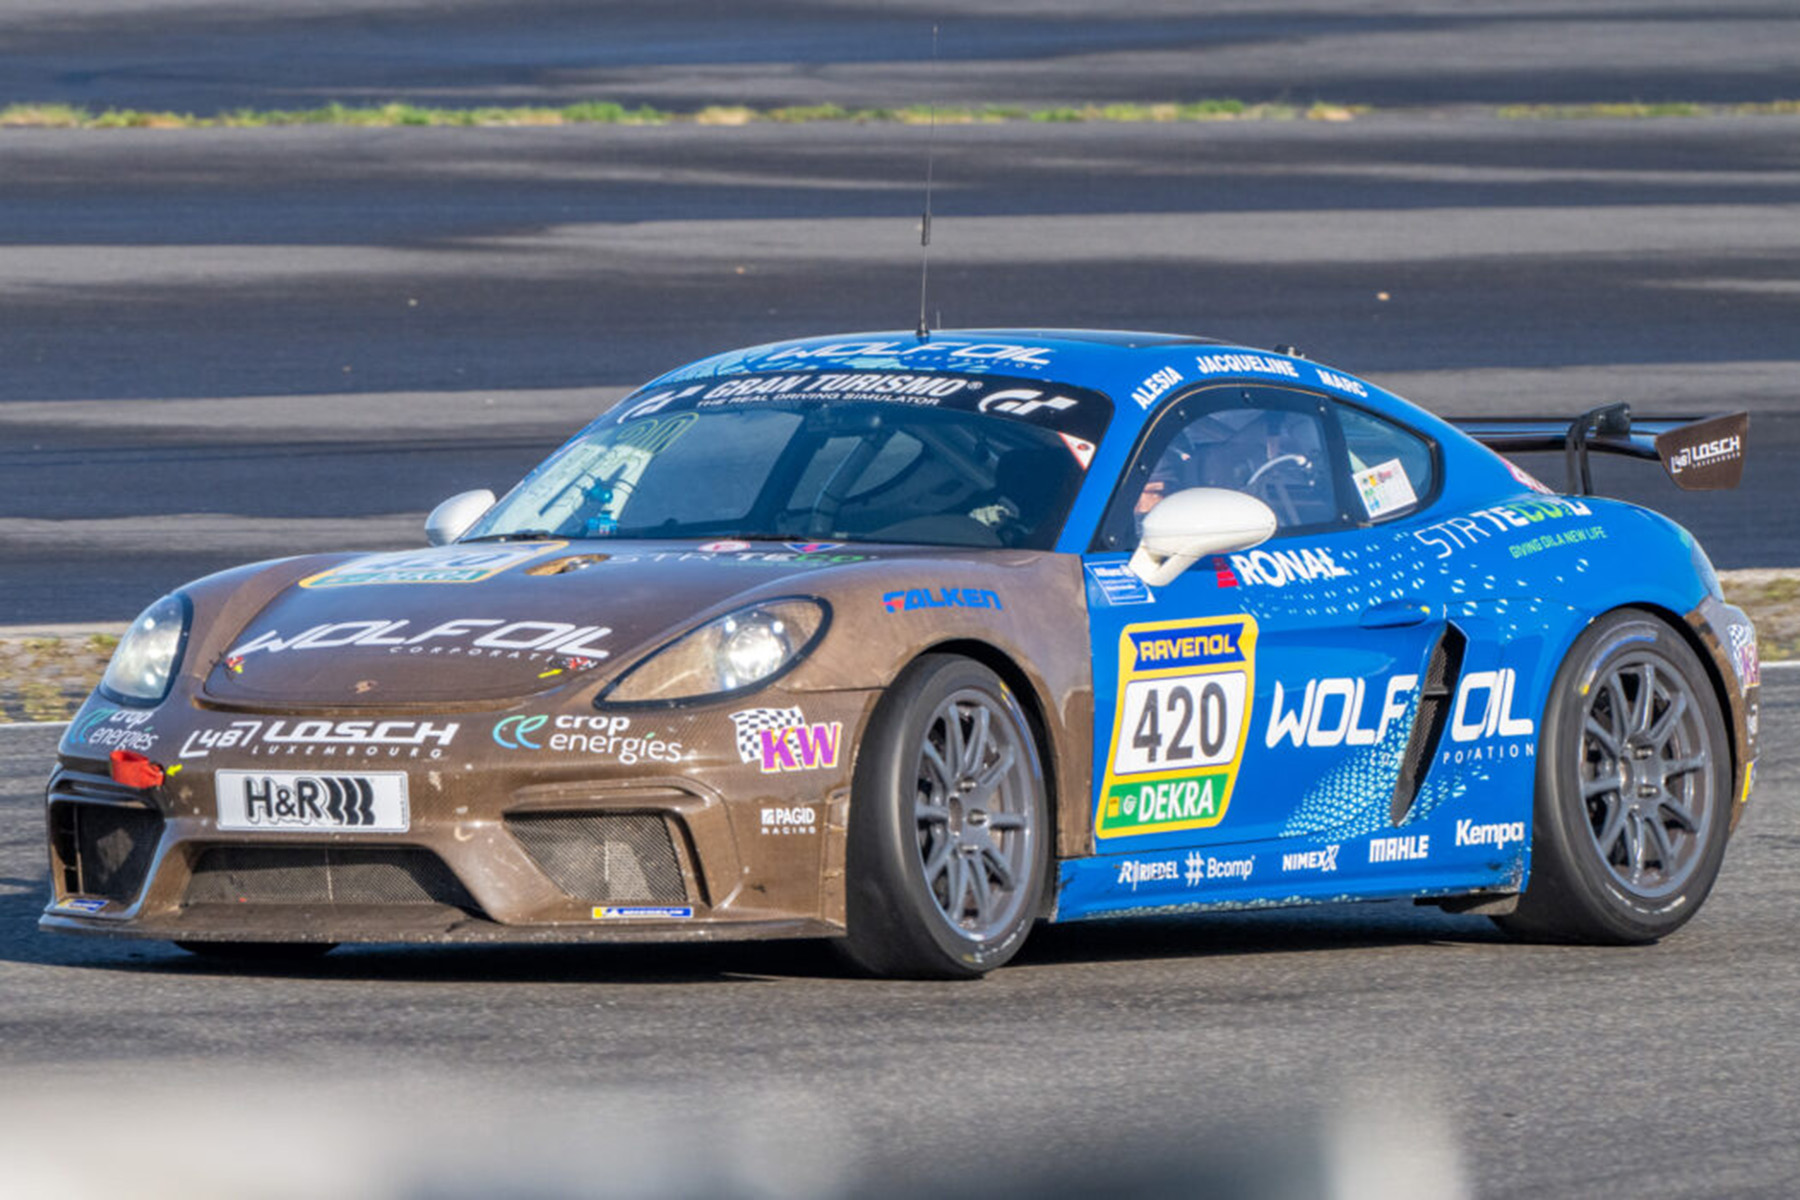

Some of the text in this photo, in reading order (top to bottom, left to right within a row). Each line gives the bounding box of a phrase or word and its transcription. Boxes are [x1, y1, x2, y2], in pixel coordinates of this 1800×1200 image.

[1196, 354, 1299, 378] JACQUELINE
[702, 375, 812, 399] GRAN
[1131, 366, 1183, 410] ALESIA
[1316, 368, 1368, 397] MARC
[696, 391, 941, 408] THE REAL DRIVING SIMULATOR
[1692, 435, 1741, 461] LOSCH
[1509, 538, 1543, 559] GIVING
[1562, 529, 1587, 544] NEW
[1585, 526, 1608, 540] LIFE
[1231, 547, 1349, 588] RONAL
[880, 588, 1003, 613] FALKEN
[1139, 634, 1236, 662] RAVENOL
[262, 720, 461, 745] LOSCH
[555, 714, 630, 735] crop
[1133, 681, 1227, 763] 420
[252, 743, 444, 758] LUXEMBOURG
[759, 721, 843, 774] KW
[244, 776, 323, 821] H&R
[1138, 778, 1215, 823] DEKRA
[776, 807, 816, 825] PAGID
[1456, 819, 1525, 849] Kempa
[1369, 835, 1430, 863] MAHLE
[1140, 861, 1179, 881] RIEDEL
